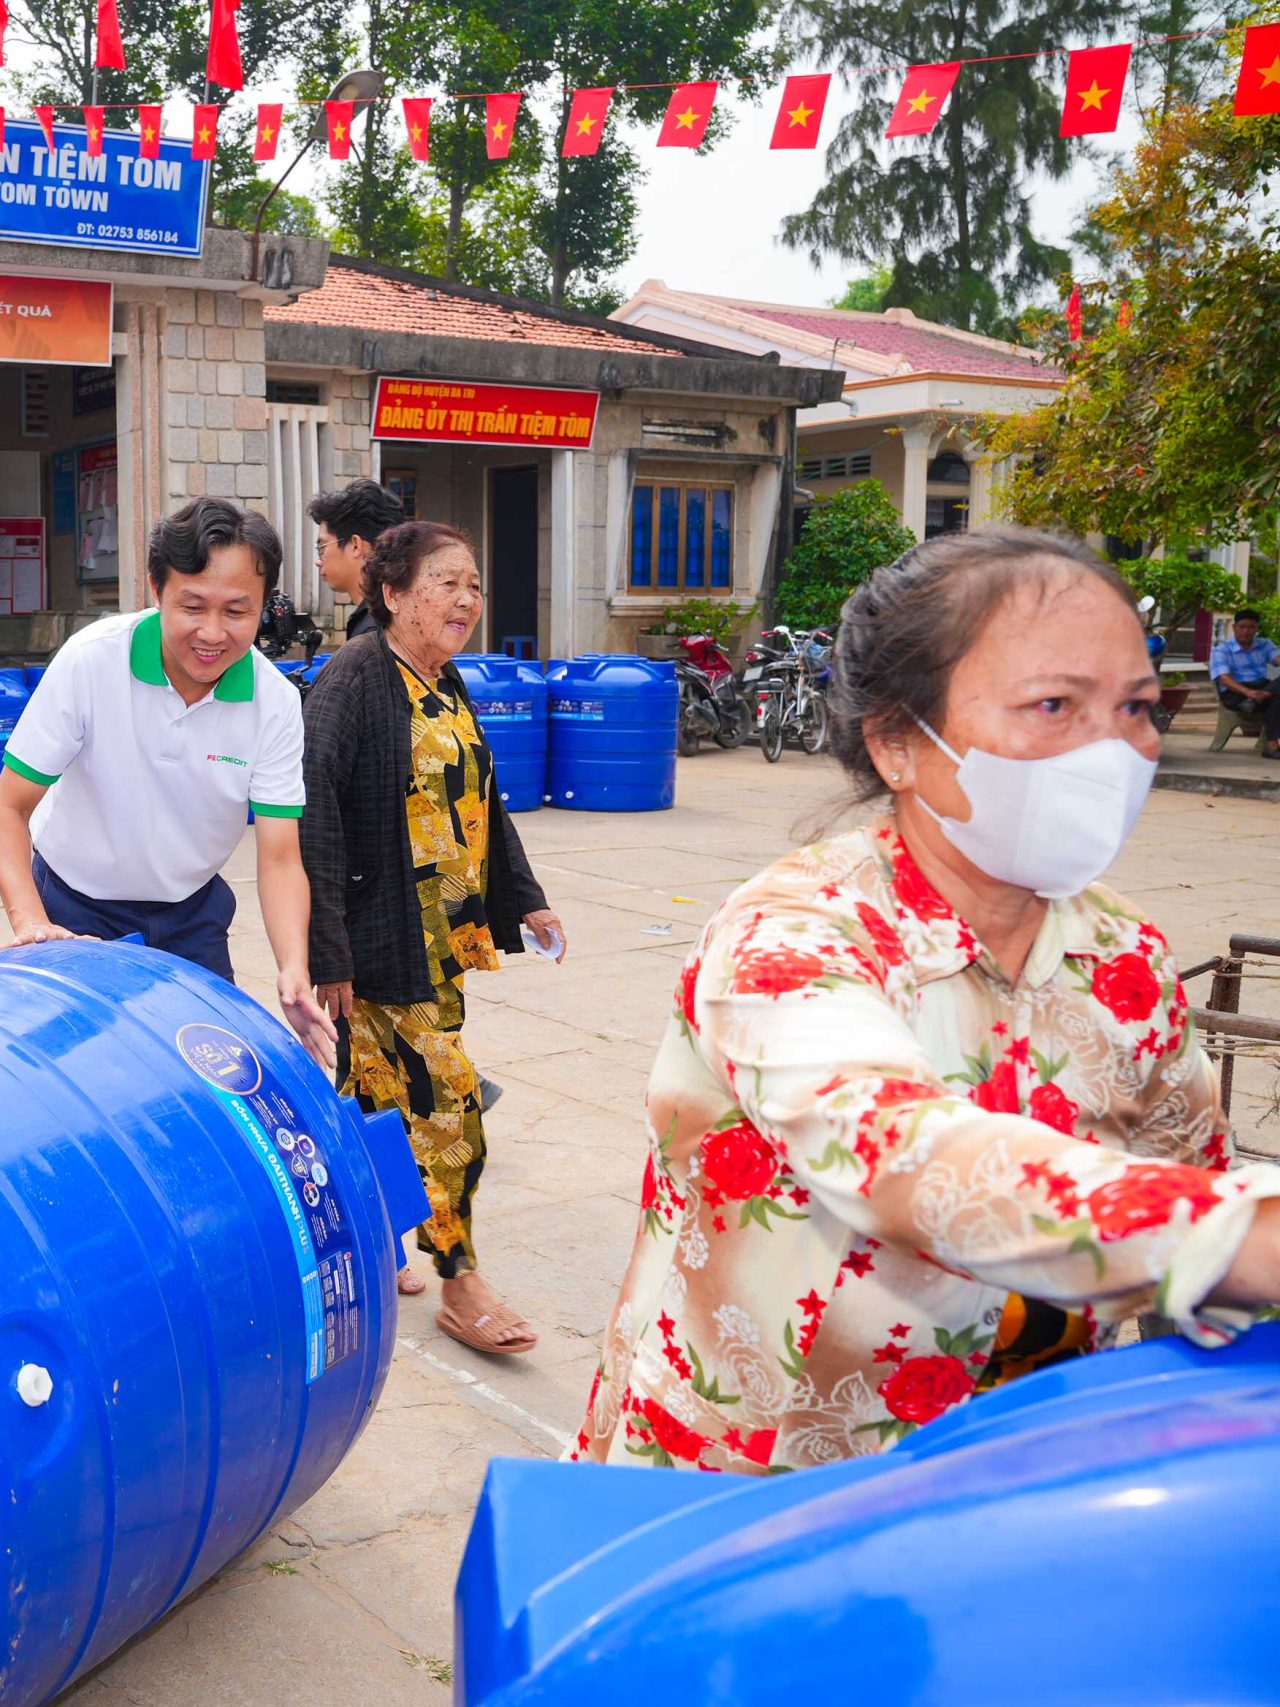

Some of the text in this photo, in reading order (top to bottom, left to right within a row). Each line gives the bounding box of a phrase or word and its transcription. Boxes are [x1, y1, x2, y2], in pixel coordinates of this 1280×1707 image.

[30, 142, 107, 186] TIỆM
[43, 185, 109, 212] TOWN
[76, 223, 179, 244] ĐT: 02753 856184
[17, 304, 52, 318] QUẢ
[379, 399, 592, 440] ĐẢNG ỦY THỊ TRẤN TIỆM TÔM
